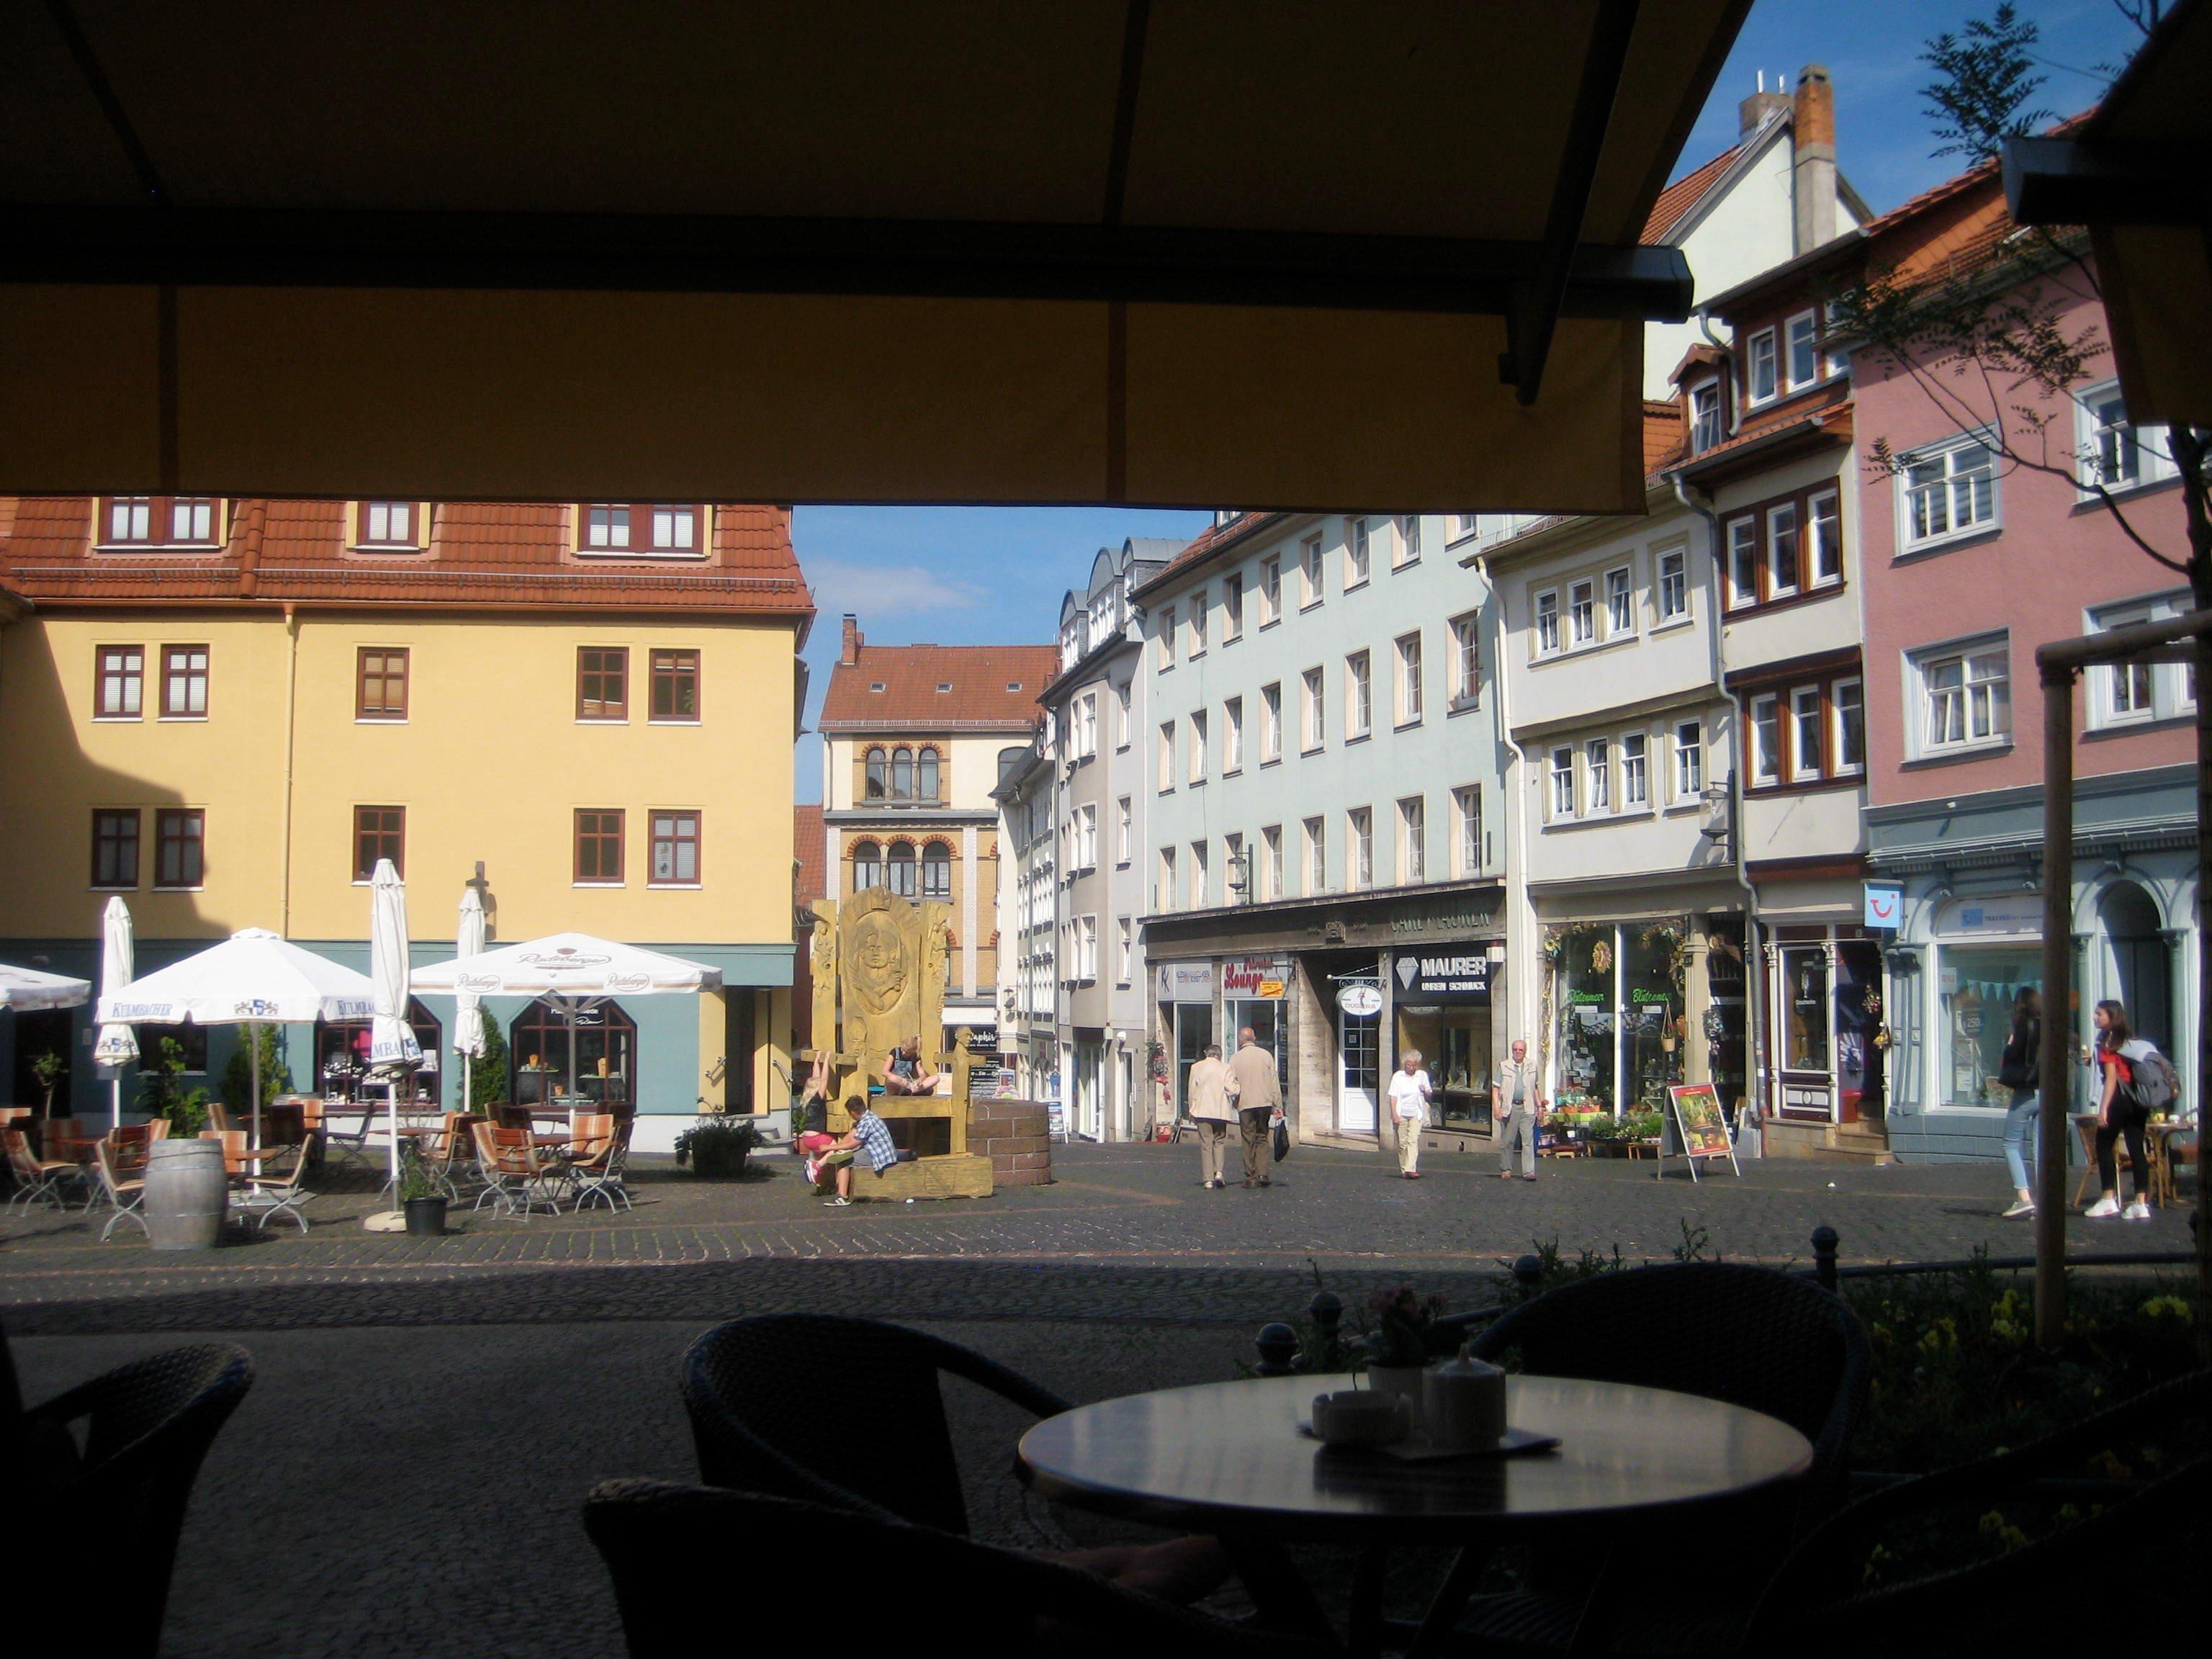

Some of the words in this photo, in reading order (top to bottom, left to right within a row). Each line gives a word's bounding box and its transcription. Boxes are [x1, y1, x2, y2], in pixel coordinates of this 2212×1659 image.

[515, 953, 608, 966] Radeberger
[1421, 956, 1487, 978] MAURER
[457, 973, 499, 988] Radeberger
[606, 973, 648, 988] Radeberger
[1224, 963, 1264, 996] Lounge
[1421, 981, 1446, 992] UHREN
[1449, 981, 1487, 992] SCHMUCK
[112, 1002, 173, 1017] KULMBACHER
[336, 999, 374, 1015] KULMBA
